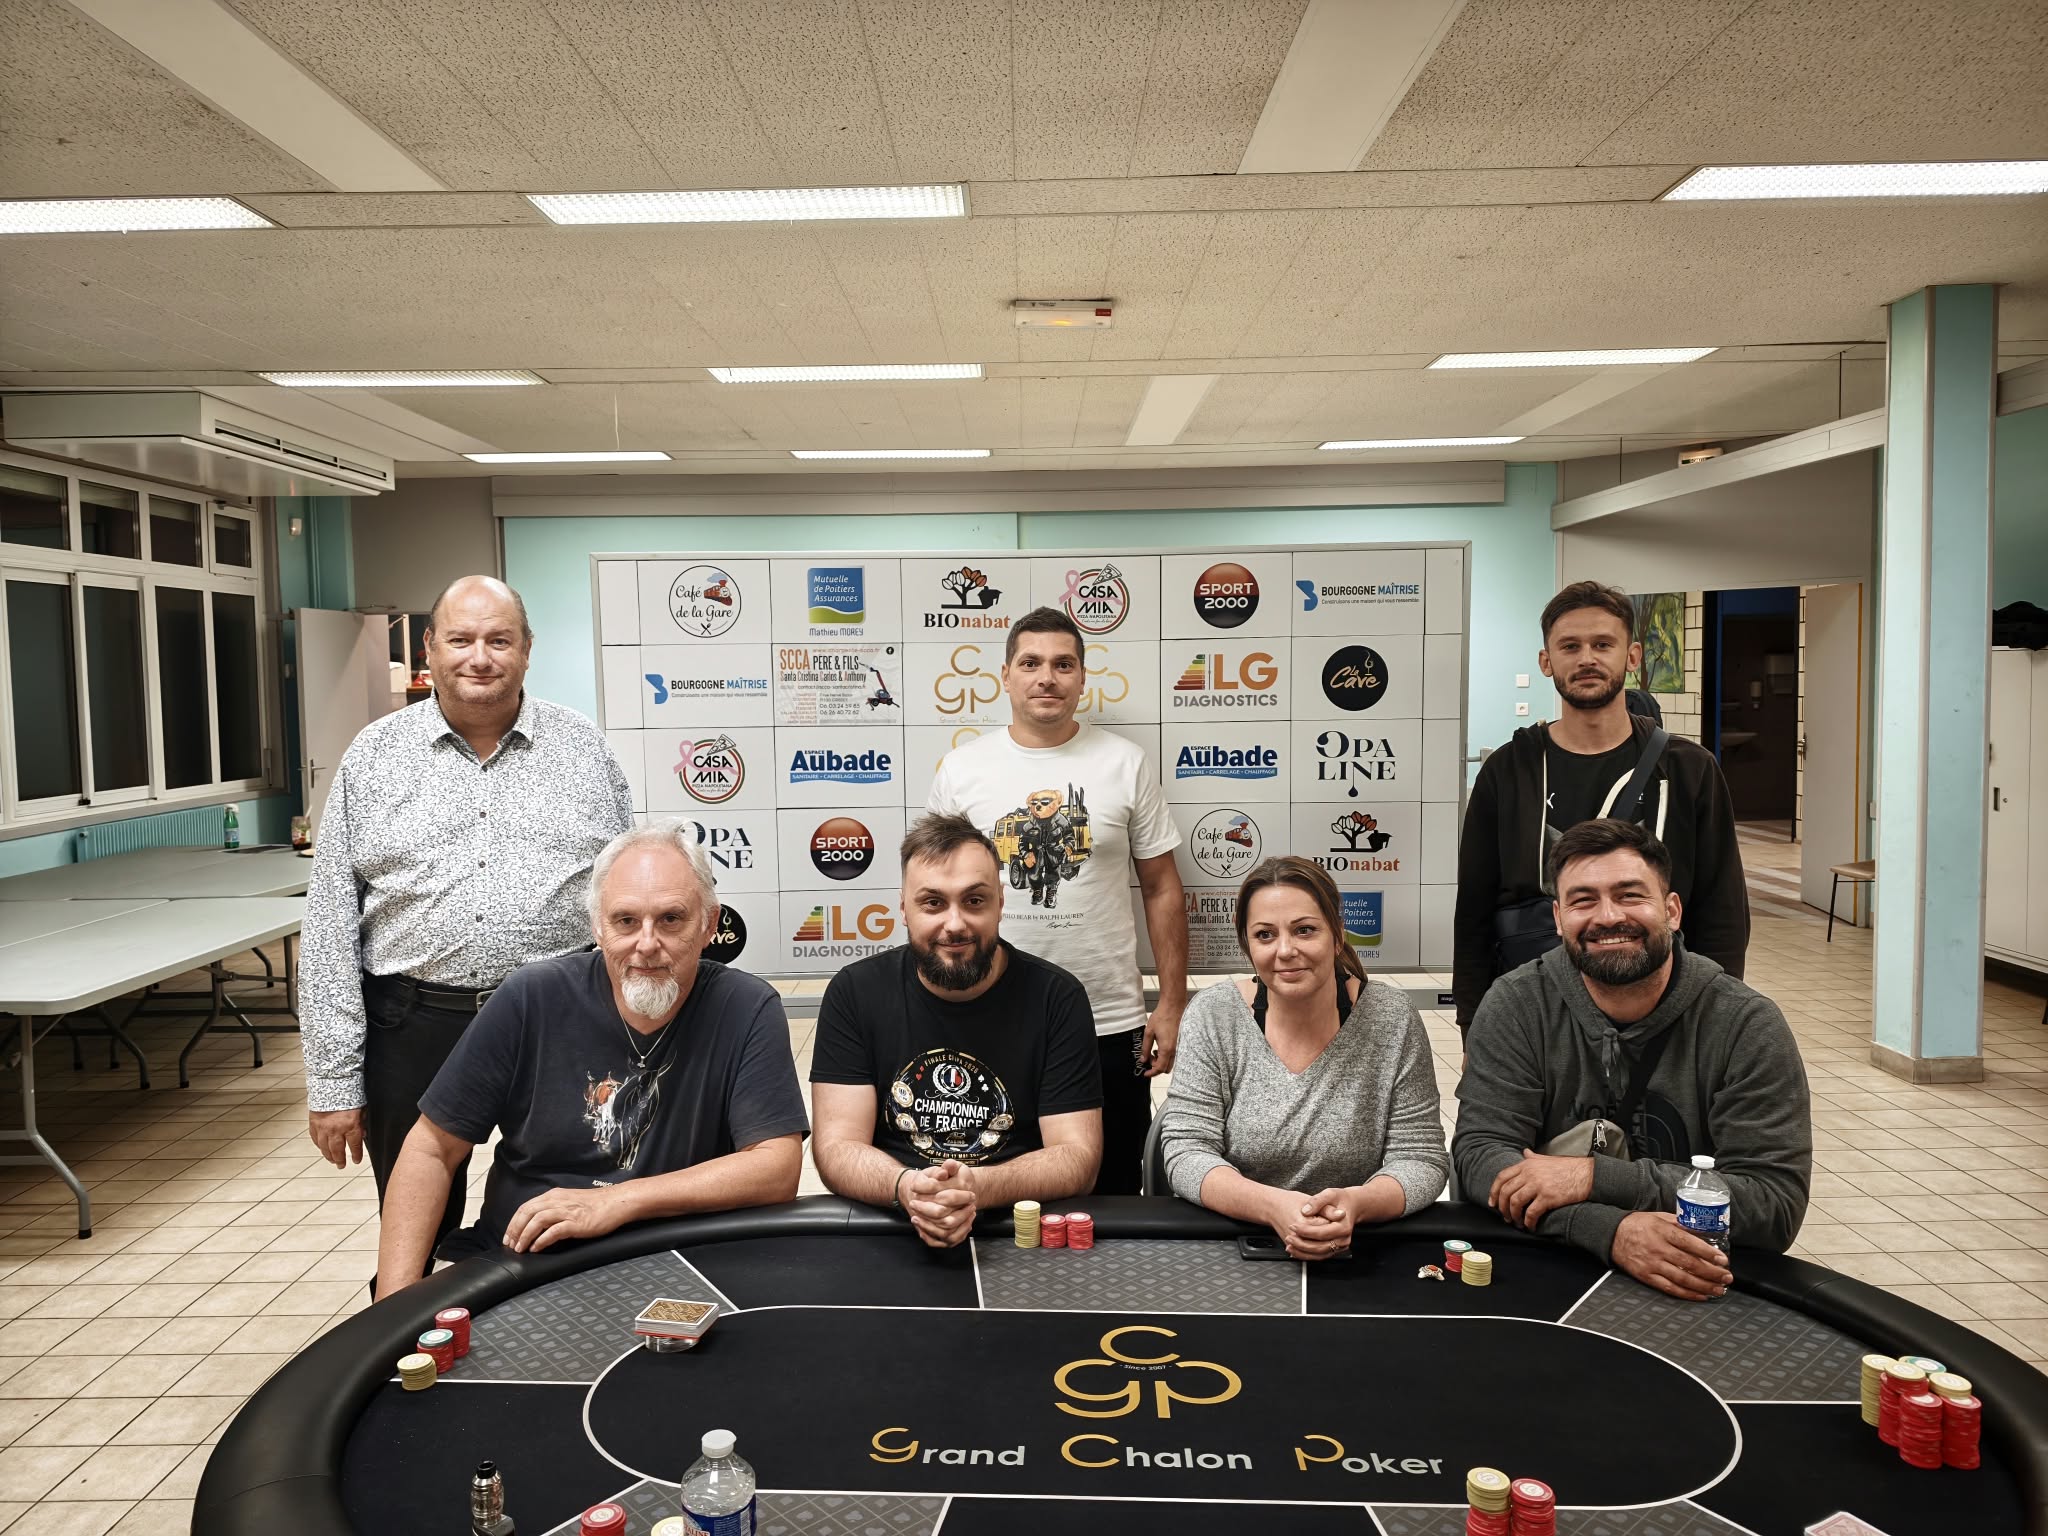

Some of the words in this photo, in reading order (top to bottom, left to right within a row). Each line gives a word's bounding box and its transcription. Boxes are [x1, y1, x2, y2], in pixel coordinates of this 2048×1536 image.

[814, 575, 848, 583] Mutuelle
[676, 586, 701, 602] Café
[814, 584, 824, 593] de
[825, 584, 855, 593] Poitiers
[1079, 585, 1118, 598] CASA
[1200, 583, 1253, 595] SPORT
[1321, 585, 1376, 596] BOURGOGNE
[1378, 582, 1419, 595] MAÎTRISE
[815, 594, 858, 602] Assurances
[1204, 597, 1248, 609] 2000
[676, 605, 690, 618] de
[691, 605, 704, 618] la
[705, 604, 733, 623] Gare
[1077, 601, 1113, 613] MIA
[924, 613, 1010, 629] BIOnabat
[809, 628, 838, 637] Mathieu
[840, 627, 864, 636] MOREY
[780, 649, 810, 670] SCCA
[813, 656, 834, 670] PERE
[835, 656, 840, 670] &
[843, 656, 859, 670] FILS
[780, 671, 796, 682] Santa
[798, 671, 819, 682] Cristina
[820, 671, 837, 682] Carlos
[838, 671, 843, 682] &
[844, 671, 866, 683] Anthony
[1214, 652, 1278, 691] LG
[1330, 666, 1380, 690] Cave
[671, 680, 725, 690] BOURGOGNE
[727, 677, 768, 689] MAÎTRISE
[1173, 694, 1278, 707] DIAGNOSTICS
[1316, 731, 1395, 758] OPA
[693, 755, 733, 768] CASA
[790, 750, 892, 771] Aubade
[1176, 745, 1278, 767] Aubade
[692, 771, 729, 783] MIA
[1317, 760, 1396, 781] LINE
[816, 836, 868, 849] SPORT
[1198, 828, 1223, 844] Café
[821, 850, 864, 862] 2000
[1197, 847, 1210, 860] de
[1212, 847, 1225, 860] la
[1226, 846, 1253, 866] Gare
[1201, 898, 1220, 912] PERE
[1222, 898, 1228, 912] &
[1060, 912, 1084, 920] LAUREN
[1208, 913, 1224, 923] Carlos
[1226, 913, 1230, 923] &
[1344, 908, 1373, 917] Poitiers
[832, 904, 895, 942] LG
[925, 1054, 946, 1067] FINALE
[914, 1098, 989, 1120] CHAMPIONNAT
[920, 1116, 930, 1127] DE
[935, 1115, 983, 1129] FRANCE
[1061, 1433, 1253, 1470] Chalon
[1294, 1434, 1443, 1475] Poker
